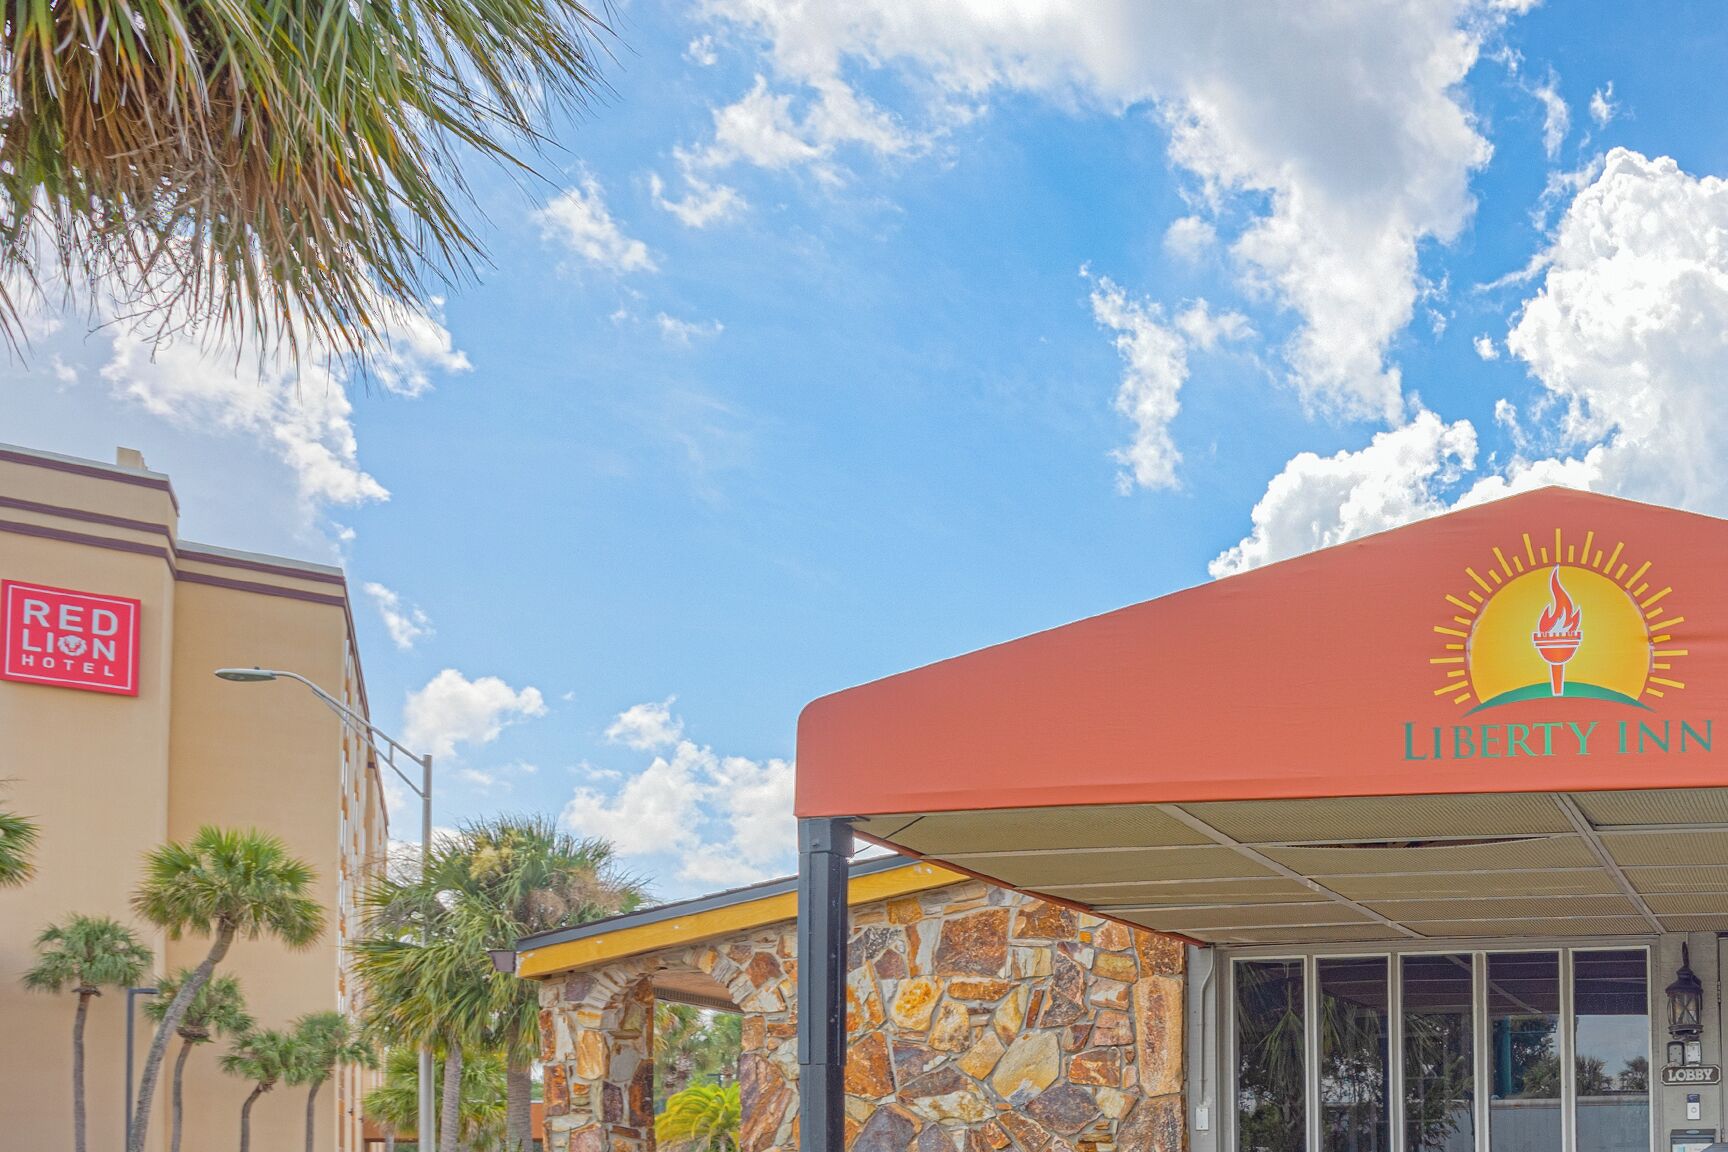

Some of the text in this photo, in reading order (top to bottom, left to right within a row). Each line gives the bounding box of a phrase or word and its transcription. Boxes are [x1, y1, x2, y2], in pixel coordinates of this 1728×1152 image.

[23, 598, 119, 637] RED
[21, 654, 115, 677] HOTEL
[1402, 719, 1714, 761] LIBERTY INN
[1667, 1068, 1714, 1082] LOBBY
